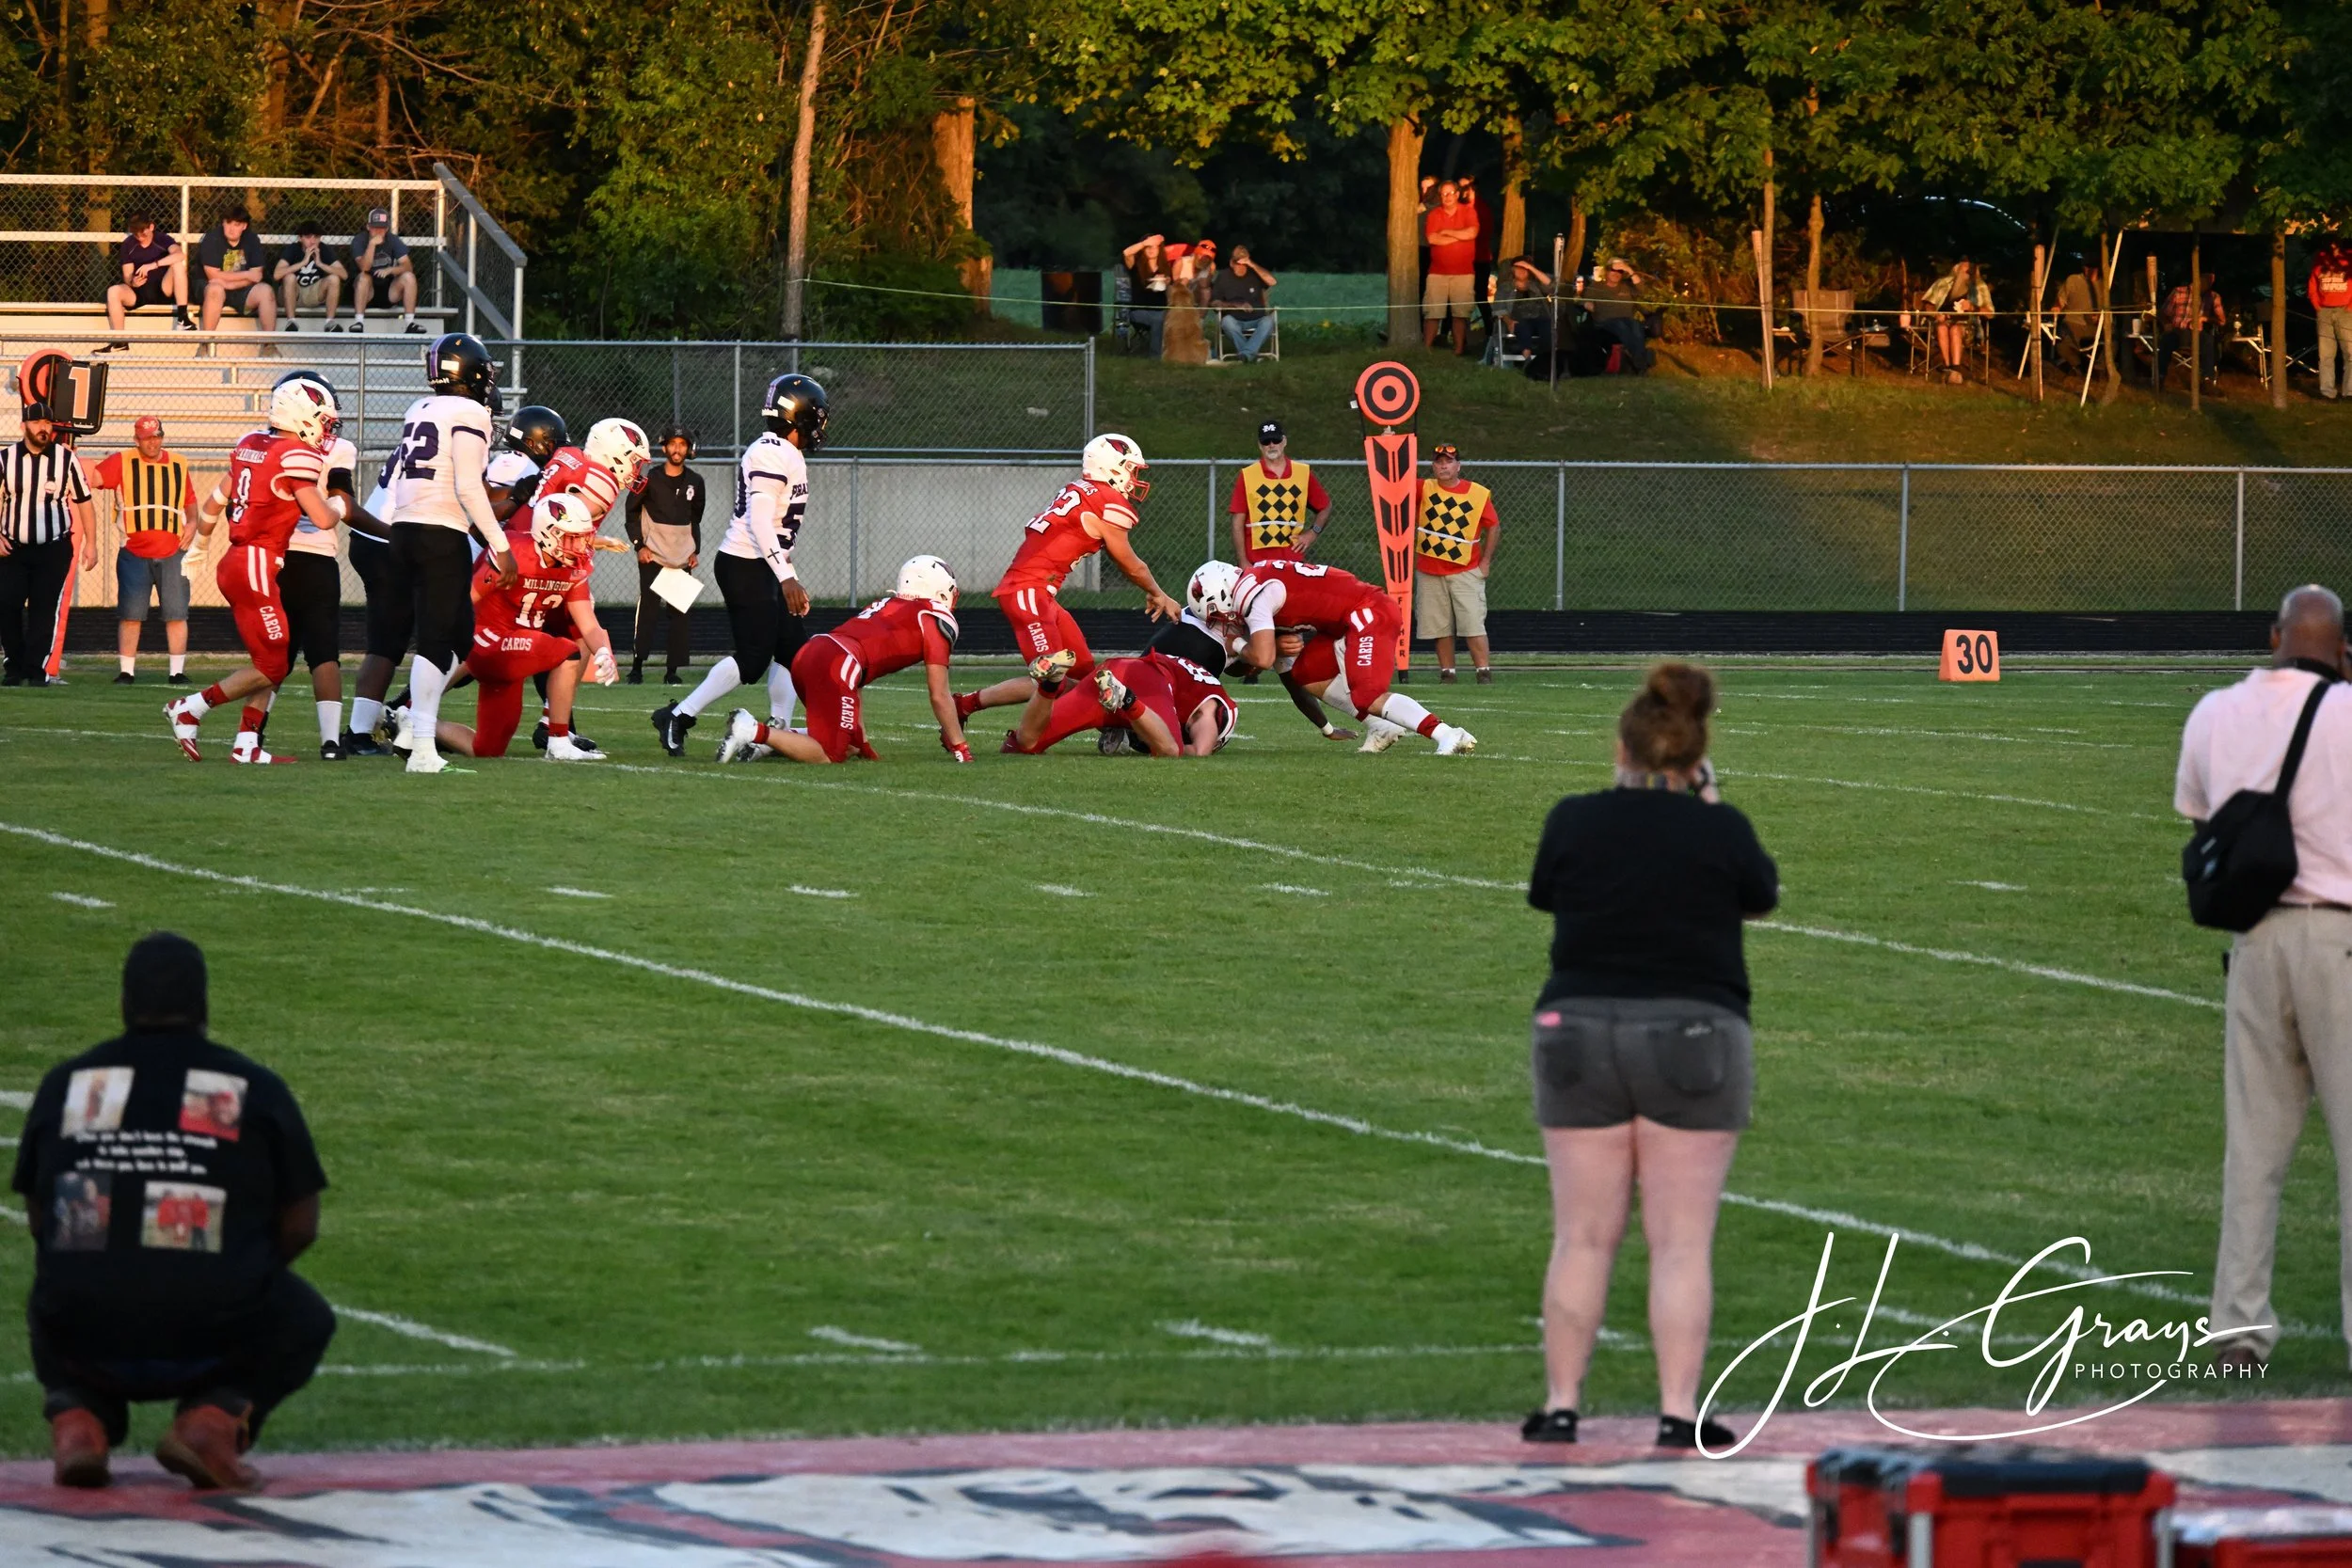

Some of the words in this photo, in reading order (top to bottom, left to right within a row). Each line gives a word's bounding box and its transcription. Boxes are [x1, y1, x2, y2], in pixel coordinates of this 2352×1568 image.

[69, 366, 90, 420] 1
[403, 421, 439, 481] 52
[259, 605, 284, 641] CARDS
[1027, 621, 1050, 653] CARDS
[1397, 596, 1406, 657] FHER
[501, 637, 534, 652] CARDS
[1357, 636, 1375, 667] CARDS
[1956, 634, 1994, 674] 30
[840, 695, 855, 731] CARDS
